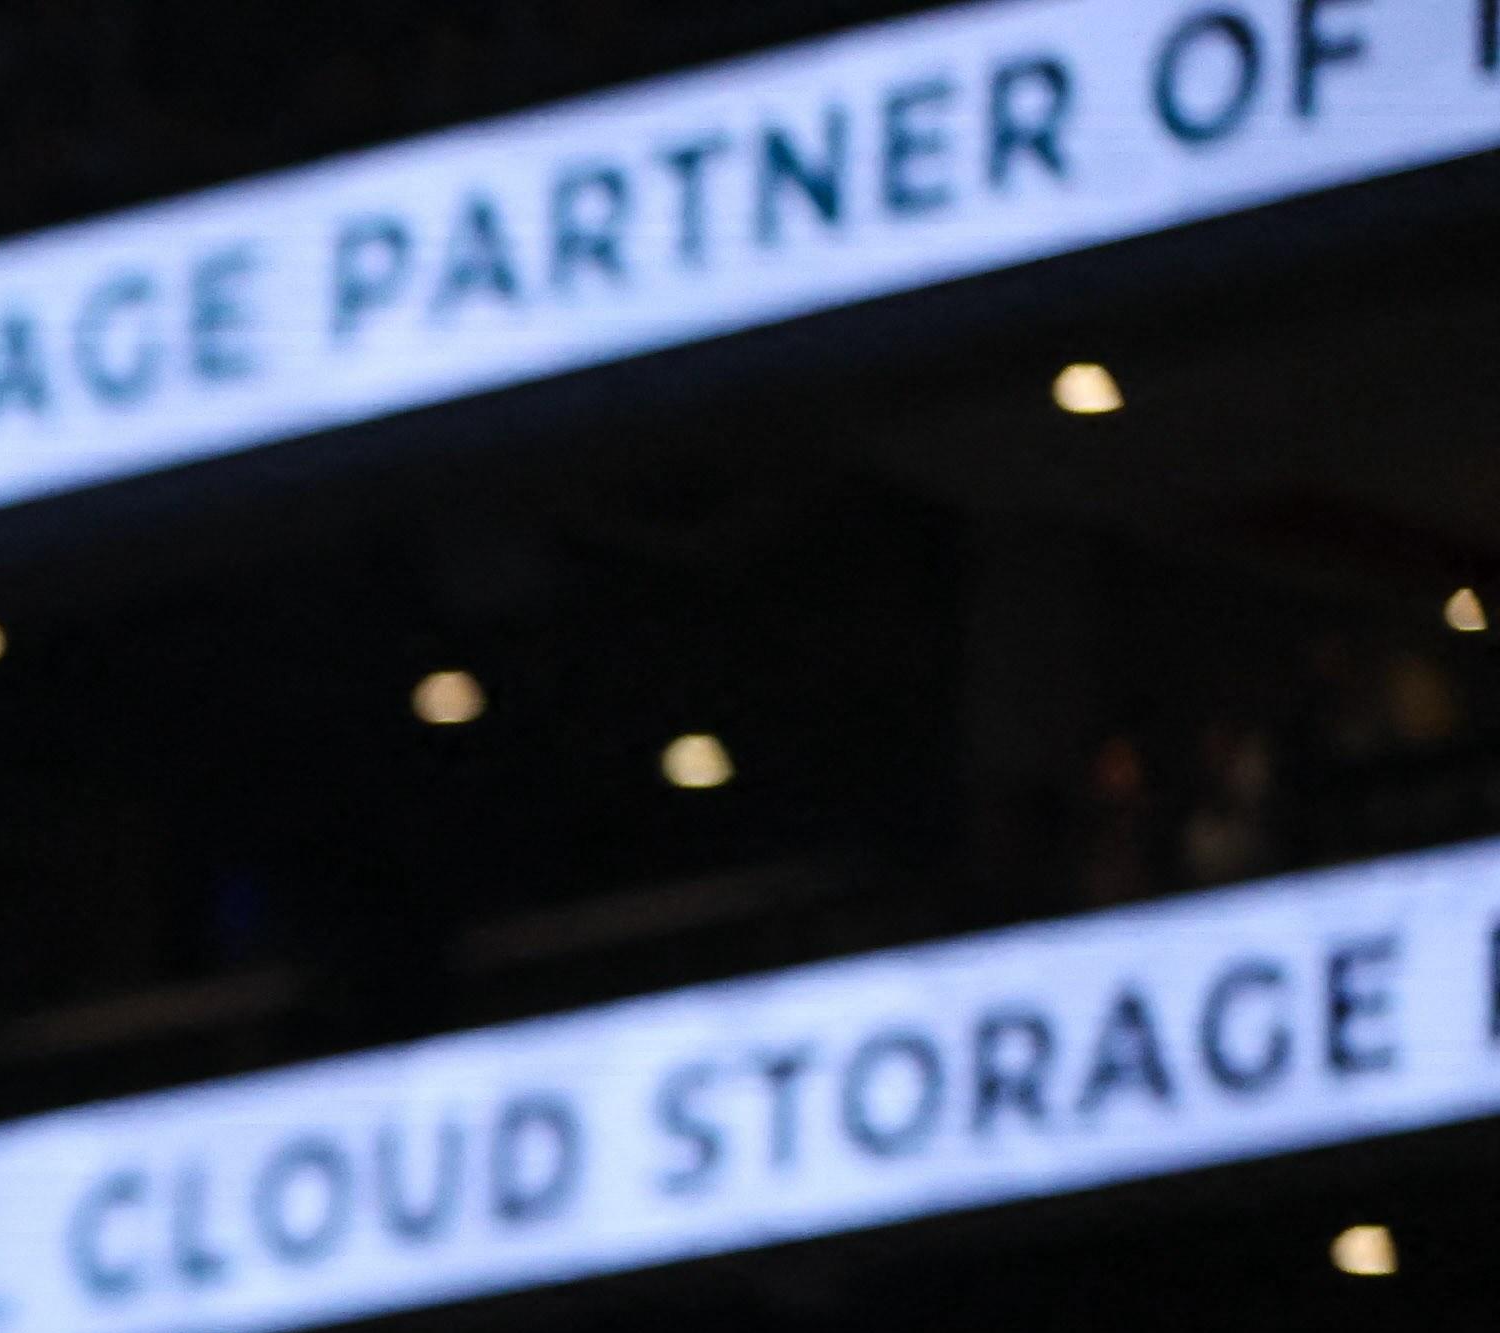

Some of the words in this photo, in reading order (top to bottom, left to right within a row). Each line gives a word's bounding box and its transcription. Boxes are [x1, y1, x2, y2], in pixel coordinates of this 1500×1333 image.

[328, 54, 1074, 342] PARTNER
[1150, 0, 1368, 146] OF
[66, 1092, 580, 1296] CLOUD
[650, 932, 1400, 1198] STORAGE
